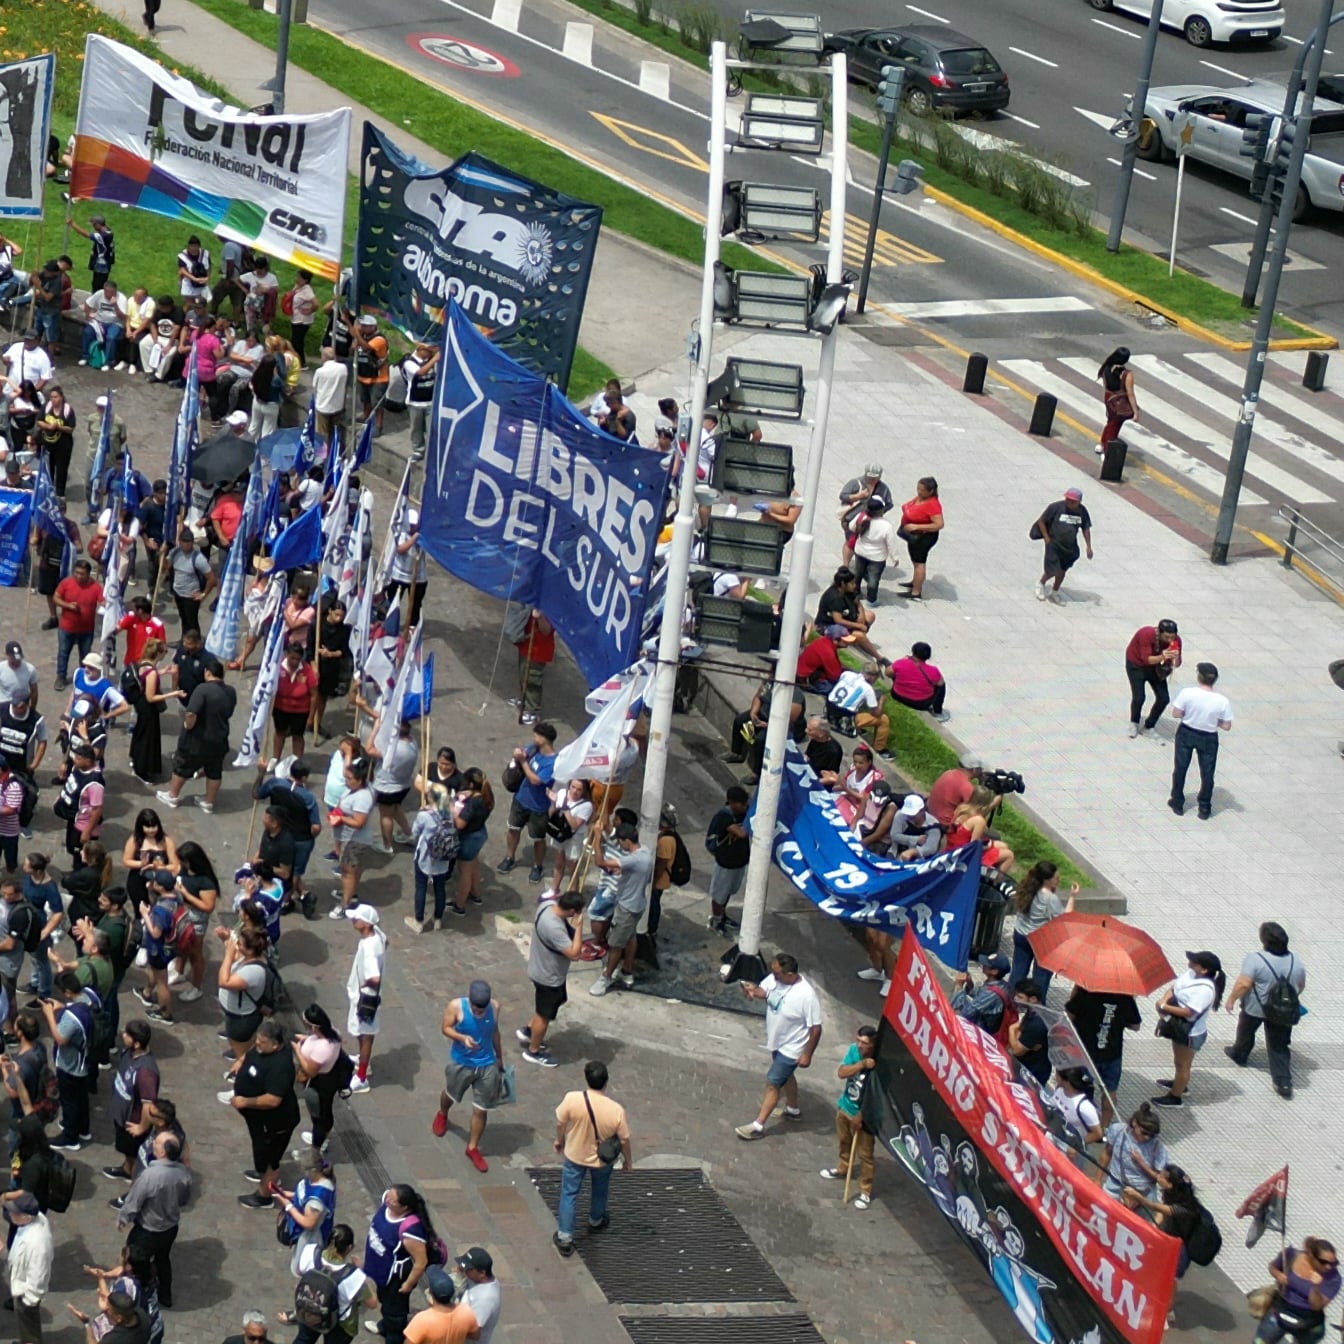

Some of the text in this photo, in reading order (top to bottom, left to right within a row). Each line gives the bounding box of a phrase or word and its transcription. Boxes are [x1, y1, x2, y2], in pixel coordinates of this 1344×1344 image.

[212, 151, 256, 179] Nacional
[257, 163, 299, 196] Territorial
[465, 259, 477, 270] de
[478, 264, 488, 275] la
[488, 270, 526, 294] argentina
[477, 399, 655, 574] LIBRES
[464, 468, 632, 653] DEL SUR
[823, 860, 869, 889] 19
[897, 991, 977, 1112] DARIO
